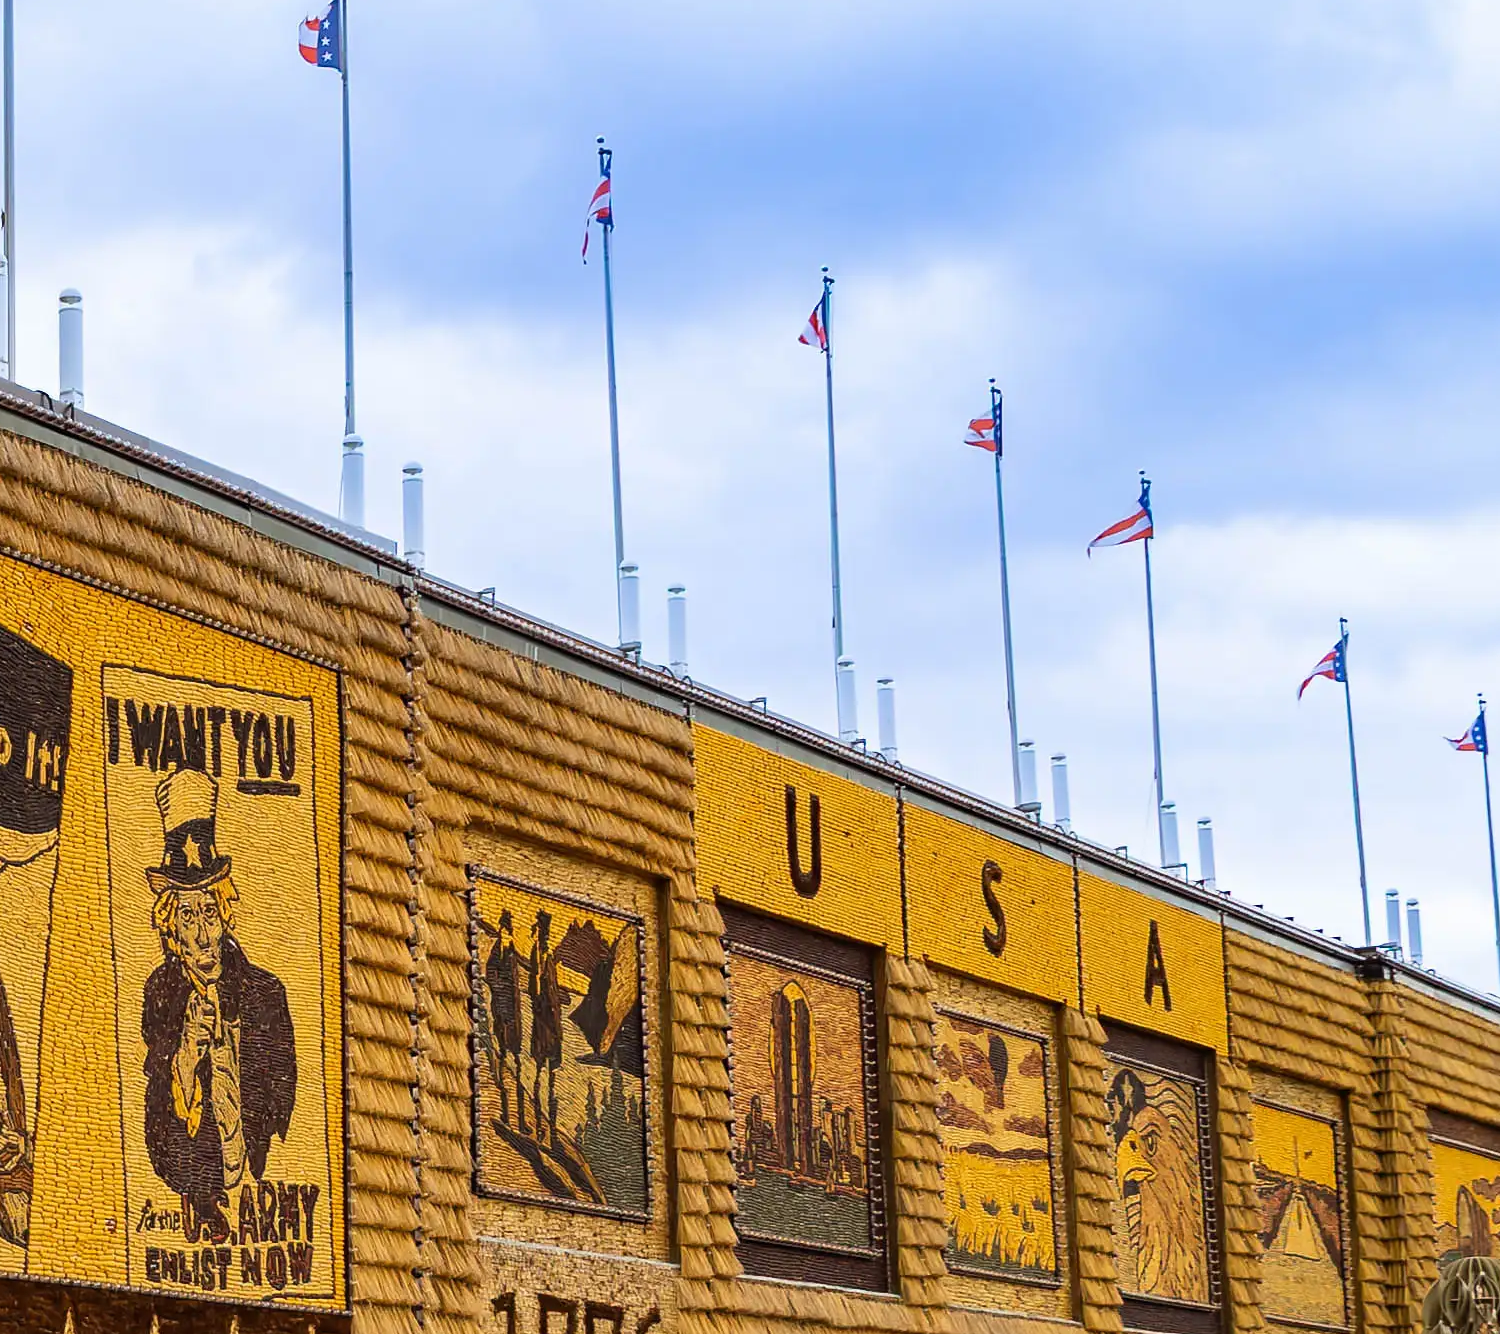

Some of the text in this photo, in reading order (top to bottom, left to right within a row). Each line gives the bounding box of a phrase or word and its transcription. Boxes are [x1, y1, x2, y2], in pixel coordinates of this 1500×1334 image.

[24, 730, 62, 791] It!
[105, 698, 296, 783] I WANT YOU
[785, 784, 1172, 1012] U S A
[239, 1179, 321, 1246] ARMY
[145, 1242, 315, 1291] ENLIST NOW
